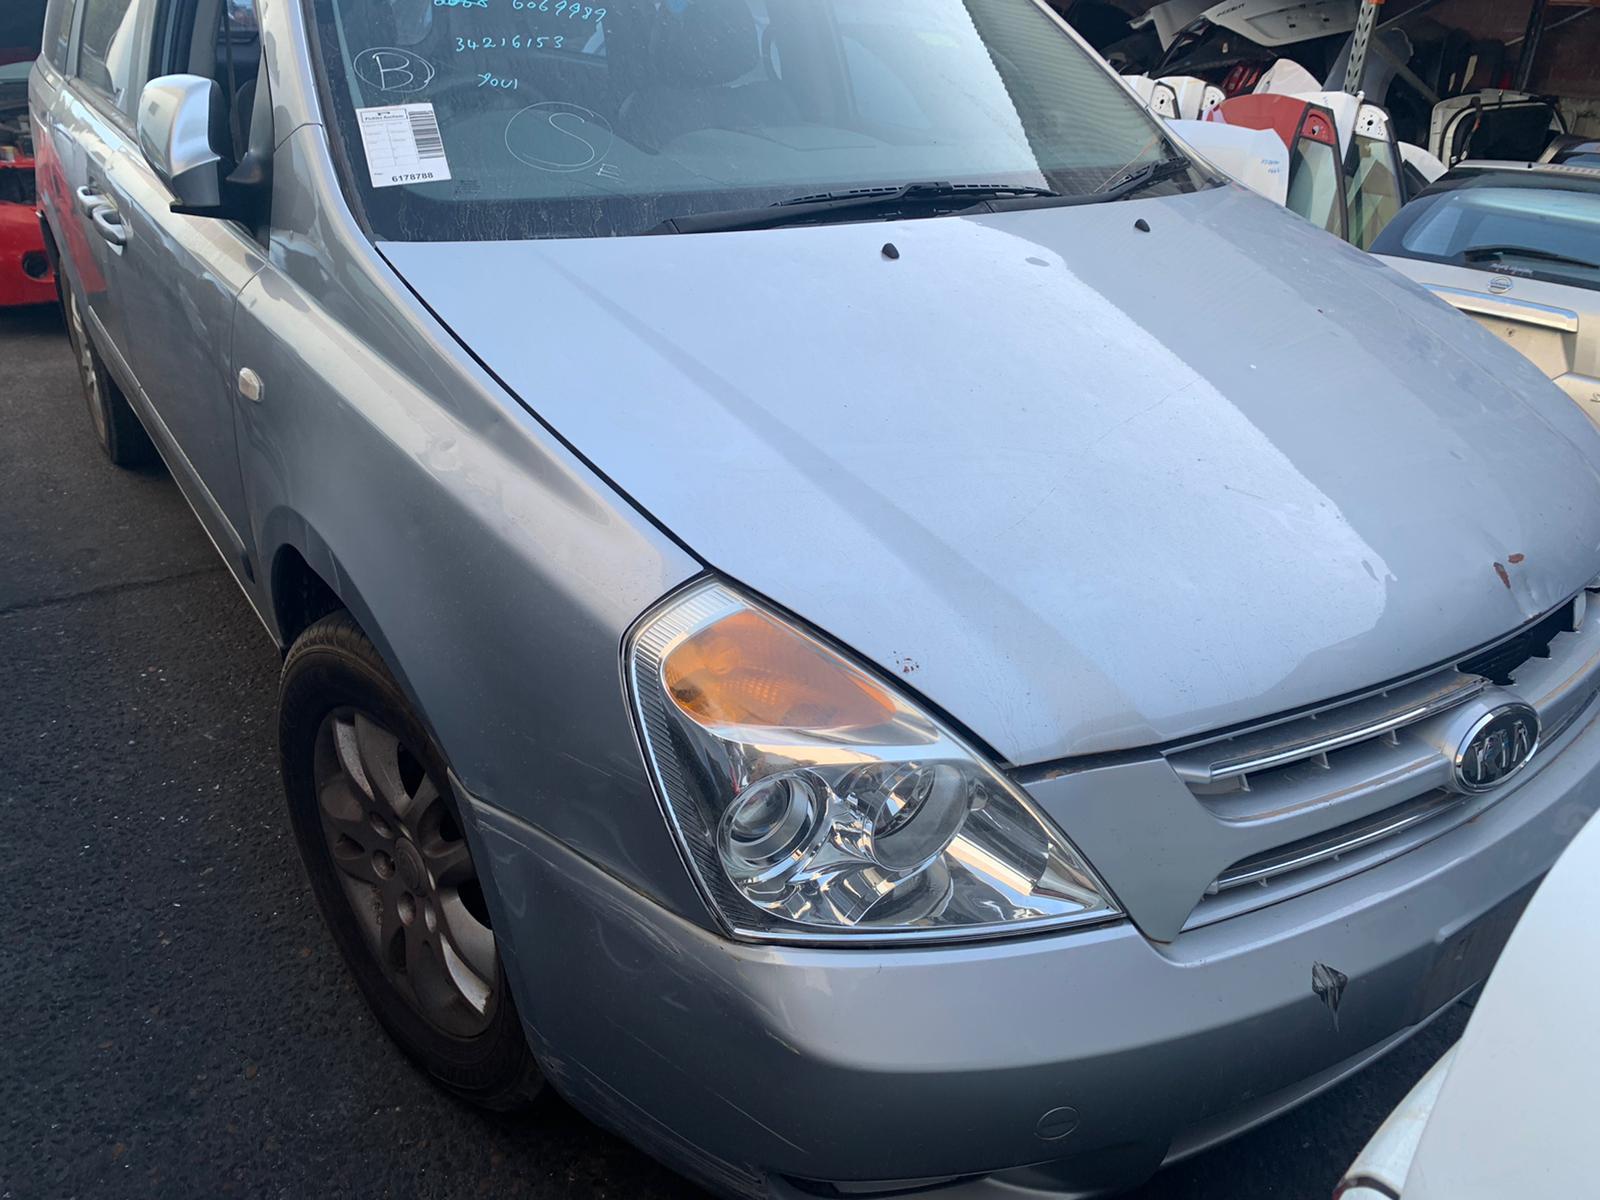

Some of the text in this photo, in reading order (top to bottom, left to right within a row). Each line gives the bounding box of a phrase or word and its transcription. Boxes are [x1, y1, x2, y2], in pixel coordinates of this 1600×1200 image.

[455, 35, 564, 52] 34216153
[372, 52, 414, 91] B
[391, 172, 434, 183] 6178788
[1472, 720, 1529, 781] KIA
